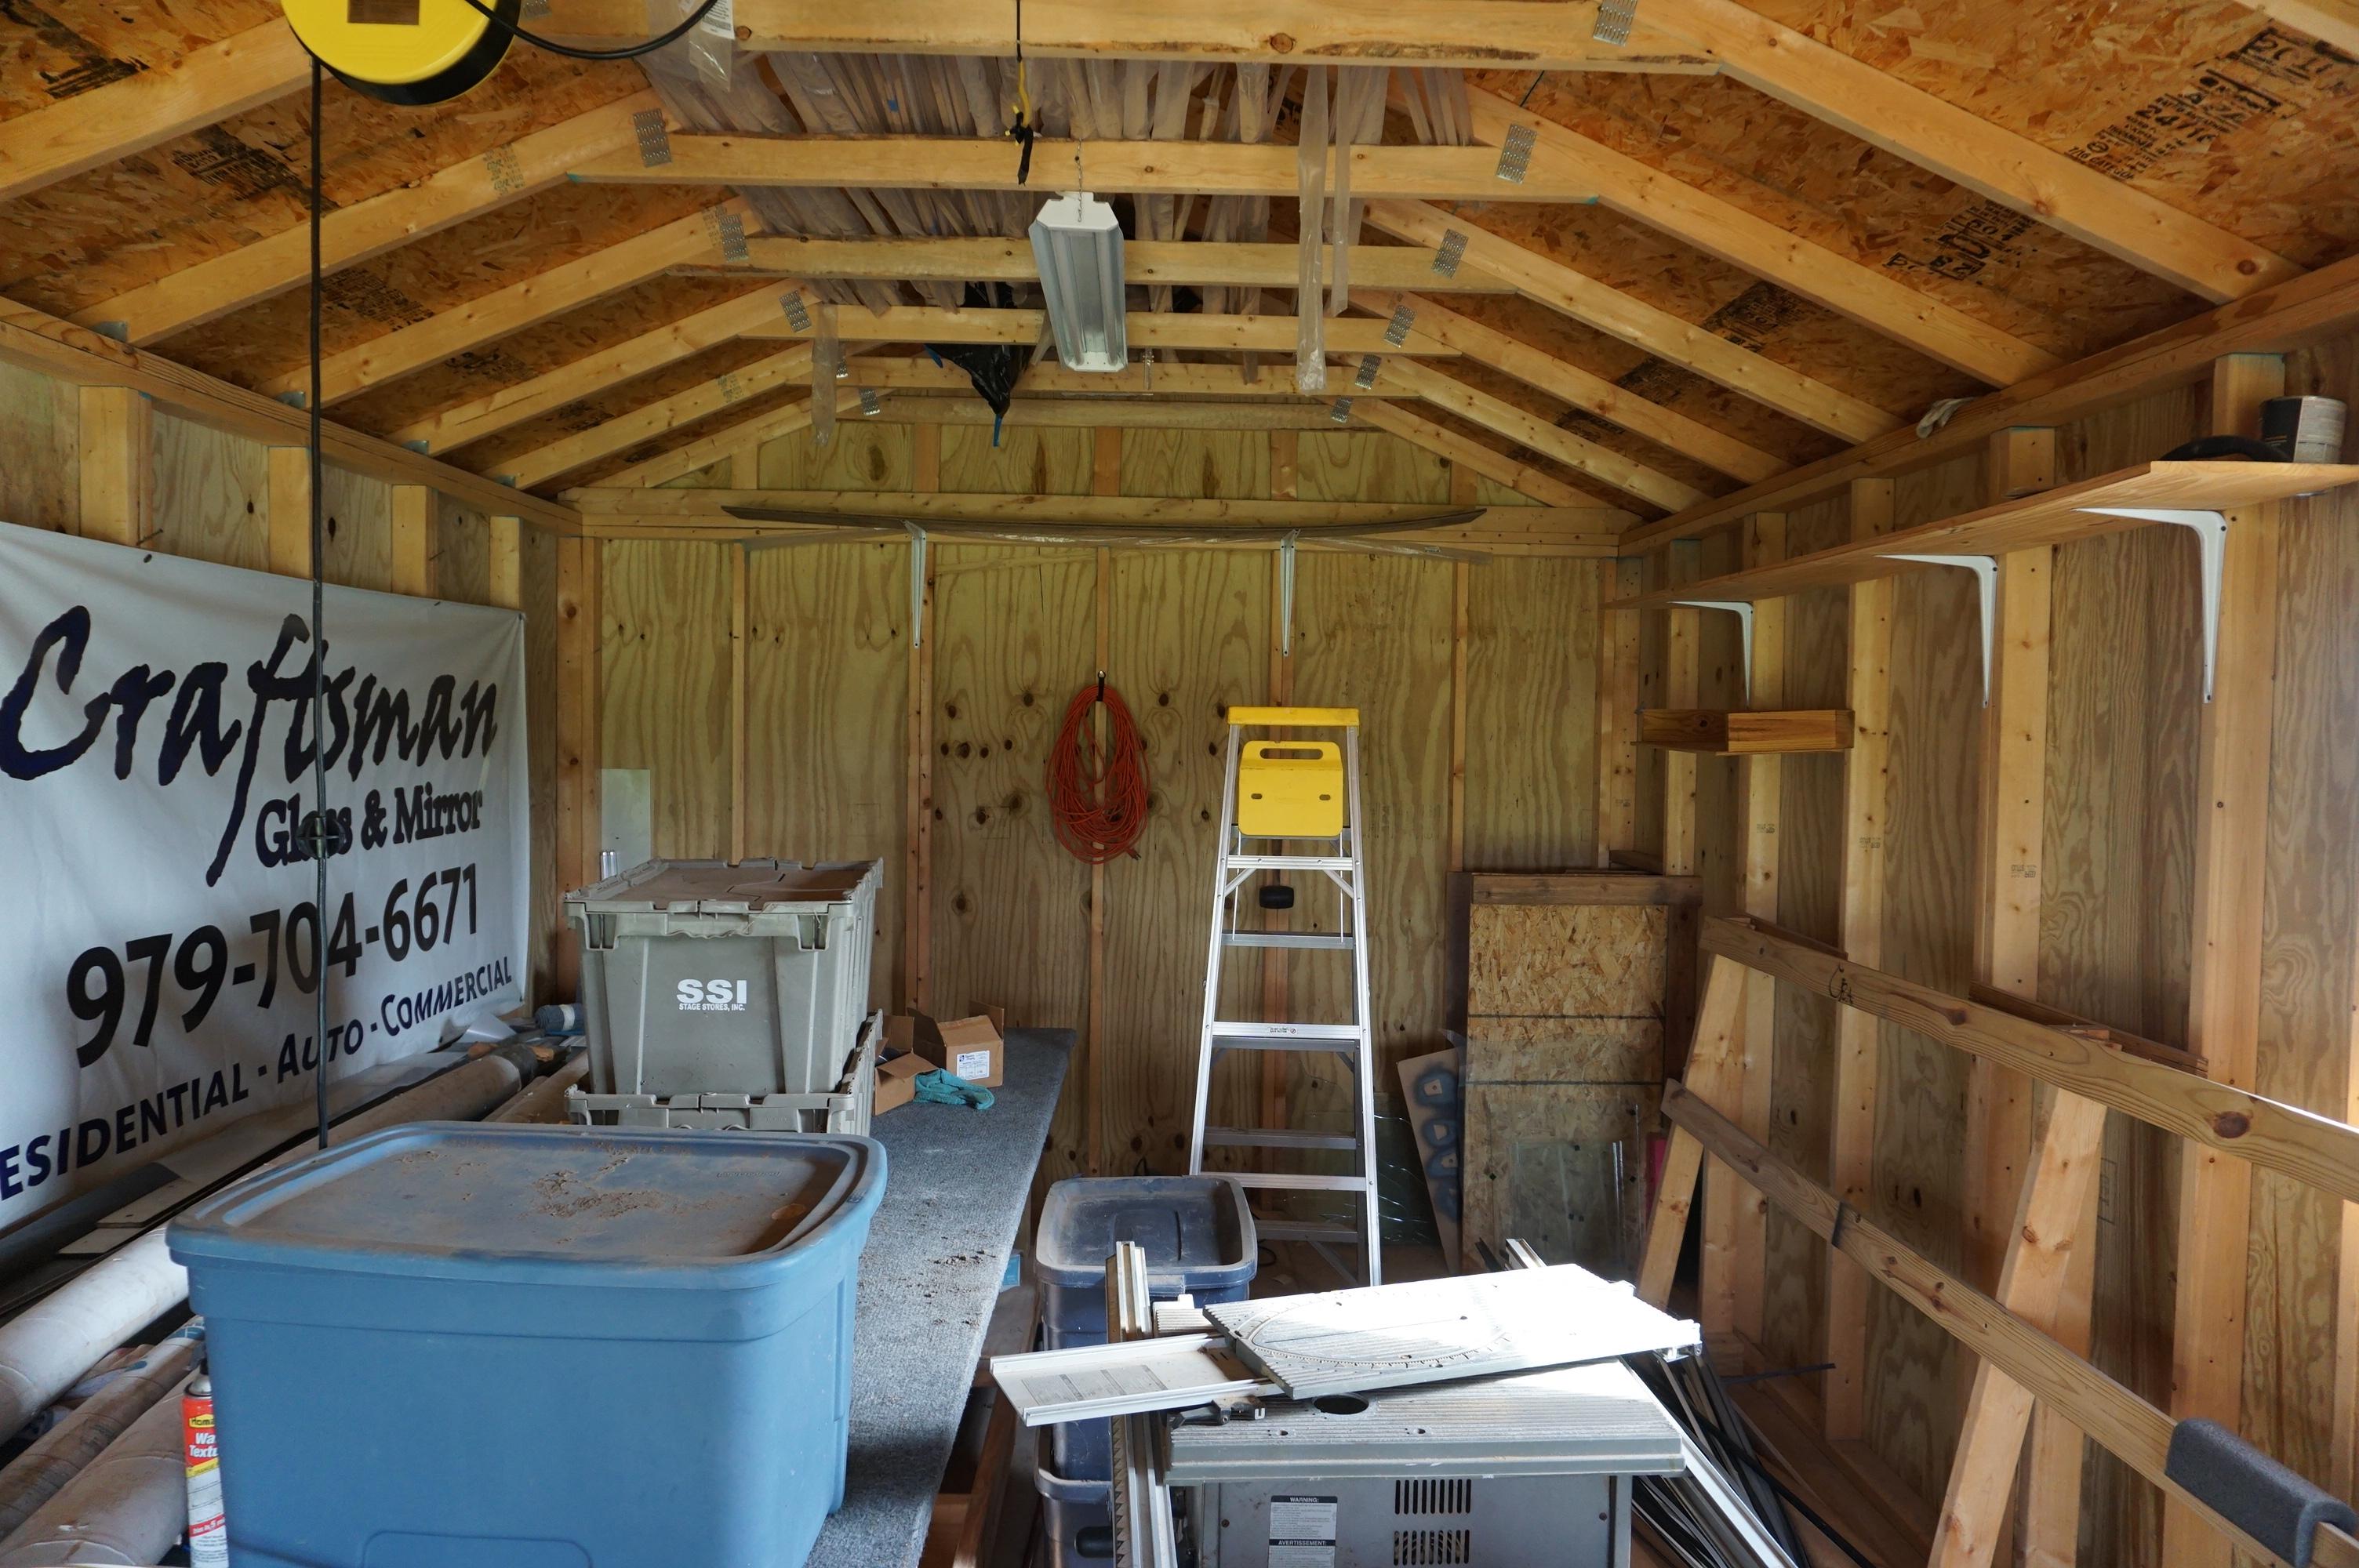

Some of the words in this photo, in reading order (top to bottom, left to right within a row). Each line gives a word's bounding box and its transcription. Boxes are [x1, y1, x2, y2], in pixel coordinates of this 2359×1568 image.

[0, 605, 498, 887] Craftsman
[361, 789, 388, 851] &
[393, 782, 483, 844] Mirror
[67, 864, 478, 1069] 979-704-6671
[676, 978, 747, 1004] SSI
[702, 1004, 730, 1012] STORES,
